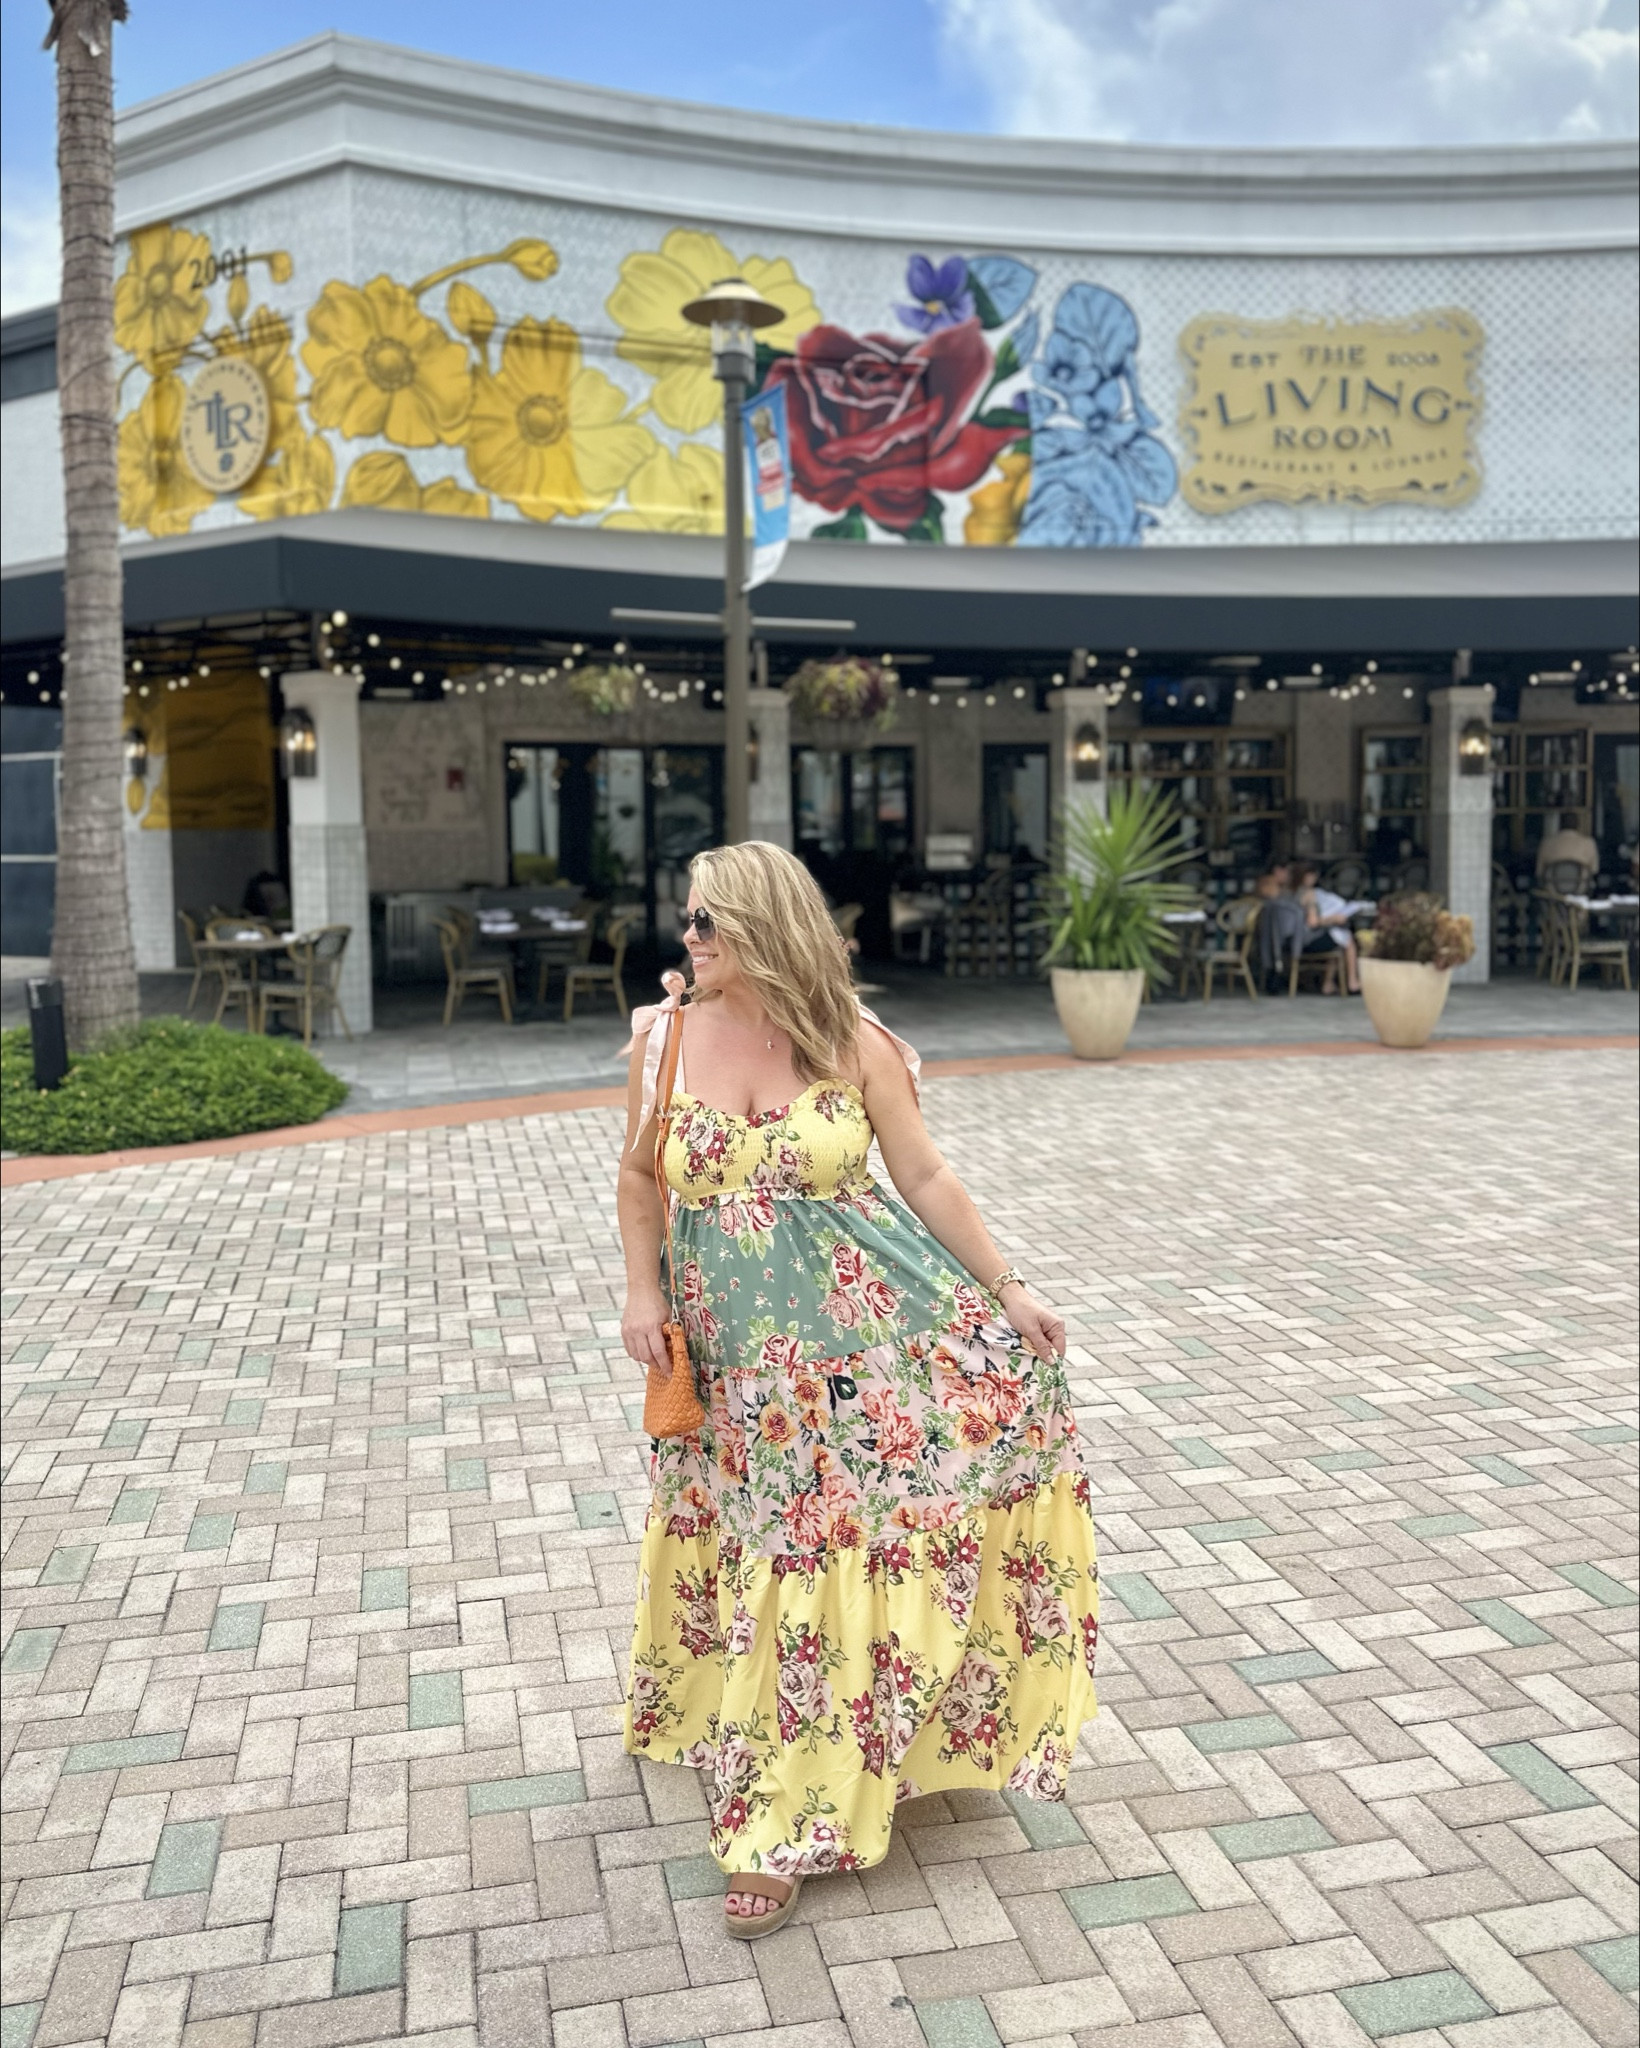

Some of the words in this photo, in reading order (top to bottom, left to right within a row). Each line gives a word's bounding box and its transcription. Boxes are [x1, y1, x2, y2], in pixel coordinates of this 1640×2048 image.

[1302, 345, 1367, 367] THE
[1215, 377, 1452, 427] LIVING
[1273, 426, 1393, 449] ROOM
